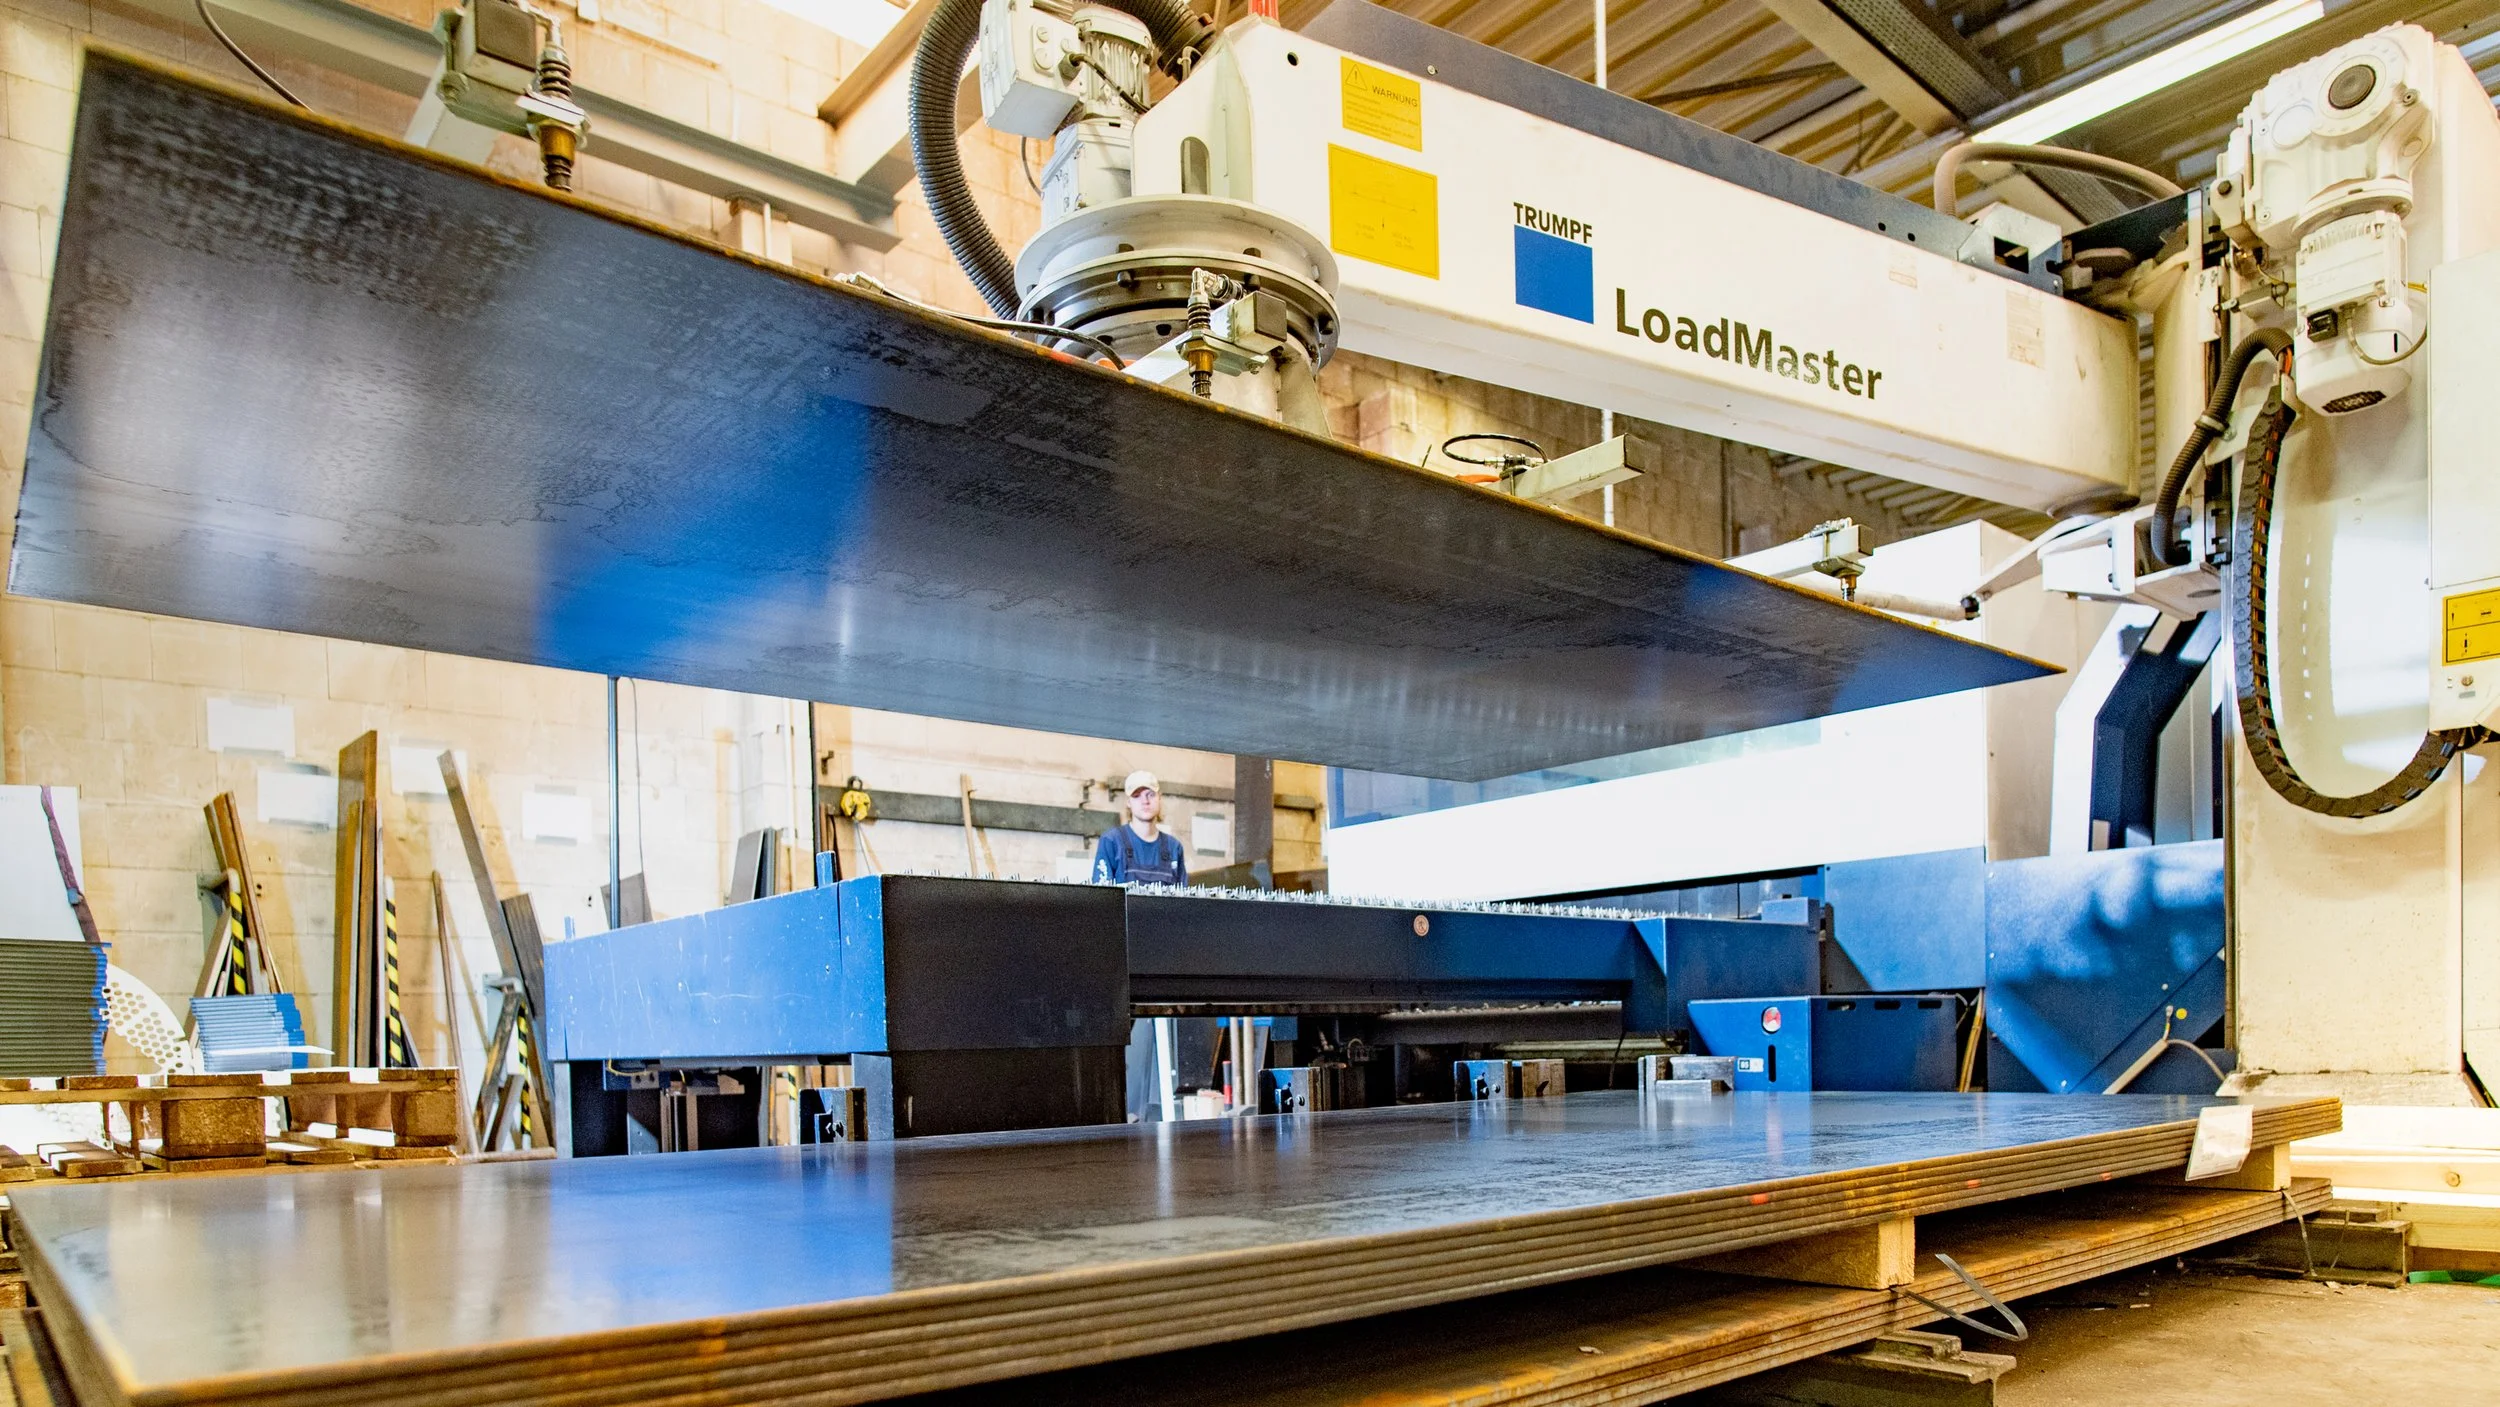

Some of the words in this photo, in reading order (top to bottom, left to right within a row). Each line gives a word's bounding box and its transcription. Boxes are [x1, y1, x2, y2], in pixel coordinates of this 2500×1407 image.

[1372, 86, 1418, 107] WARNUNG
[1513, 202, 1593, 243] TRUMPF
[1616, 287, 1882, 399] LoadMaster
